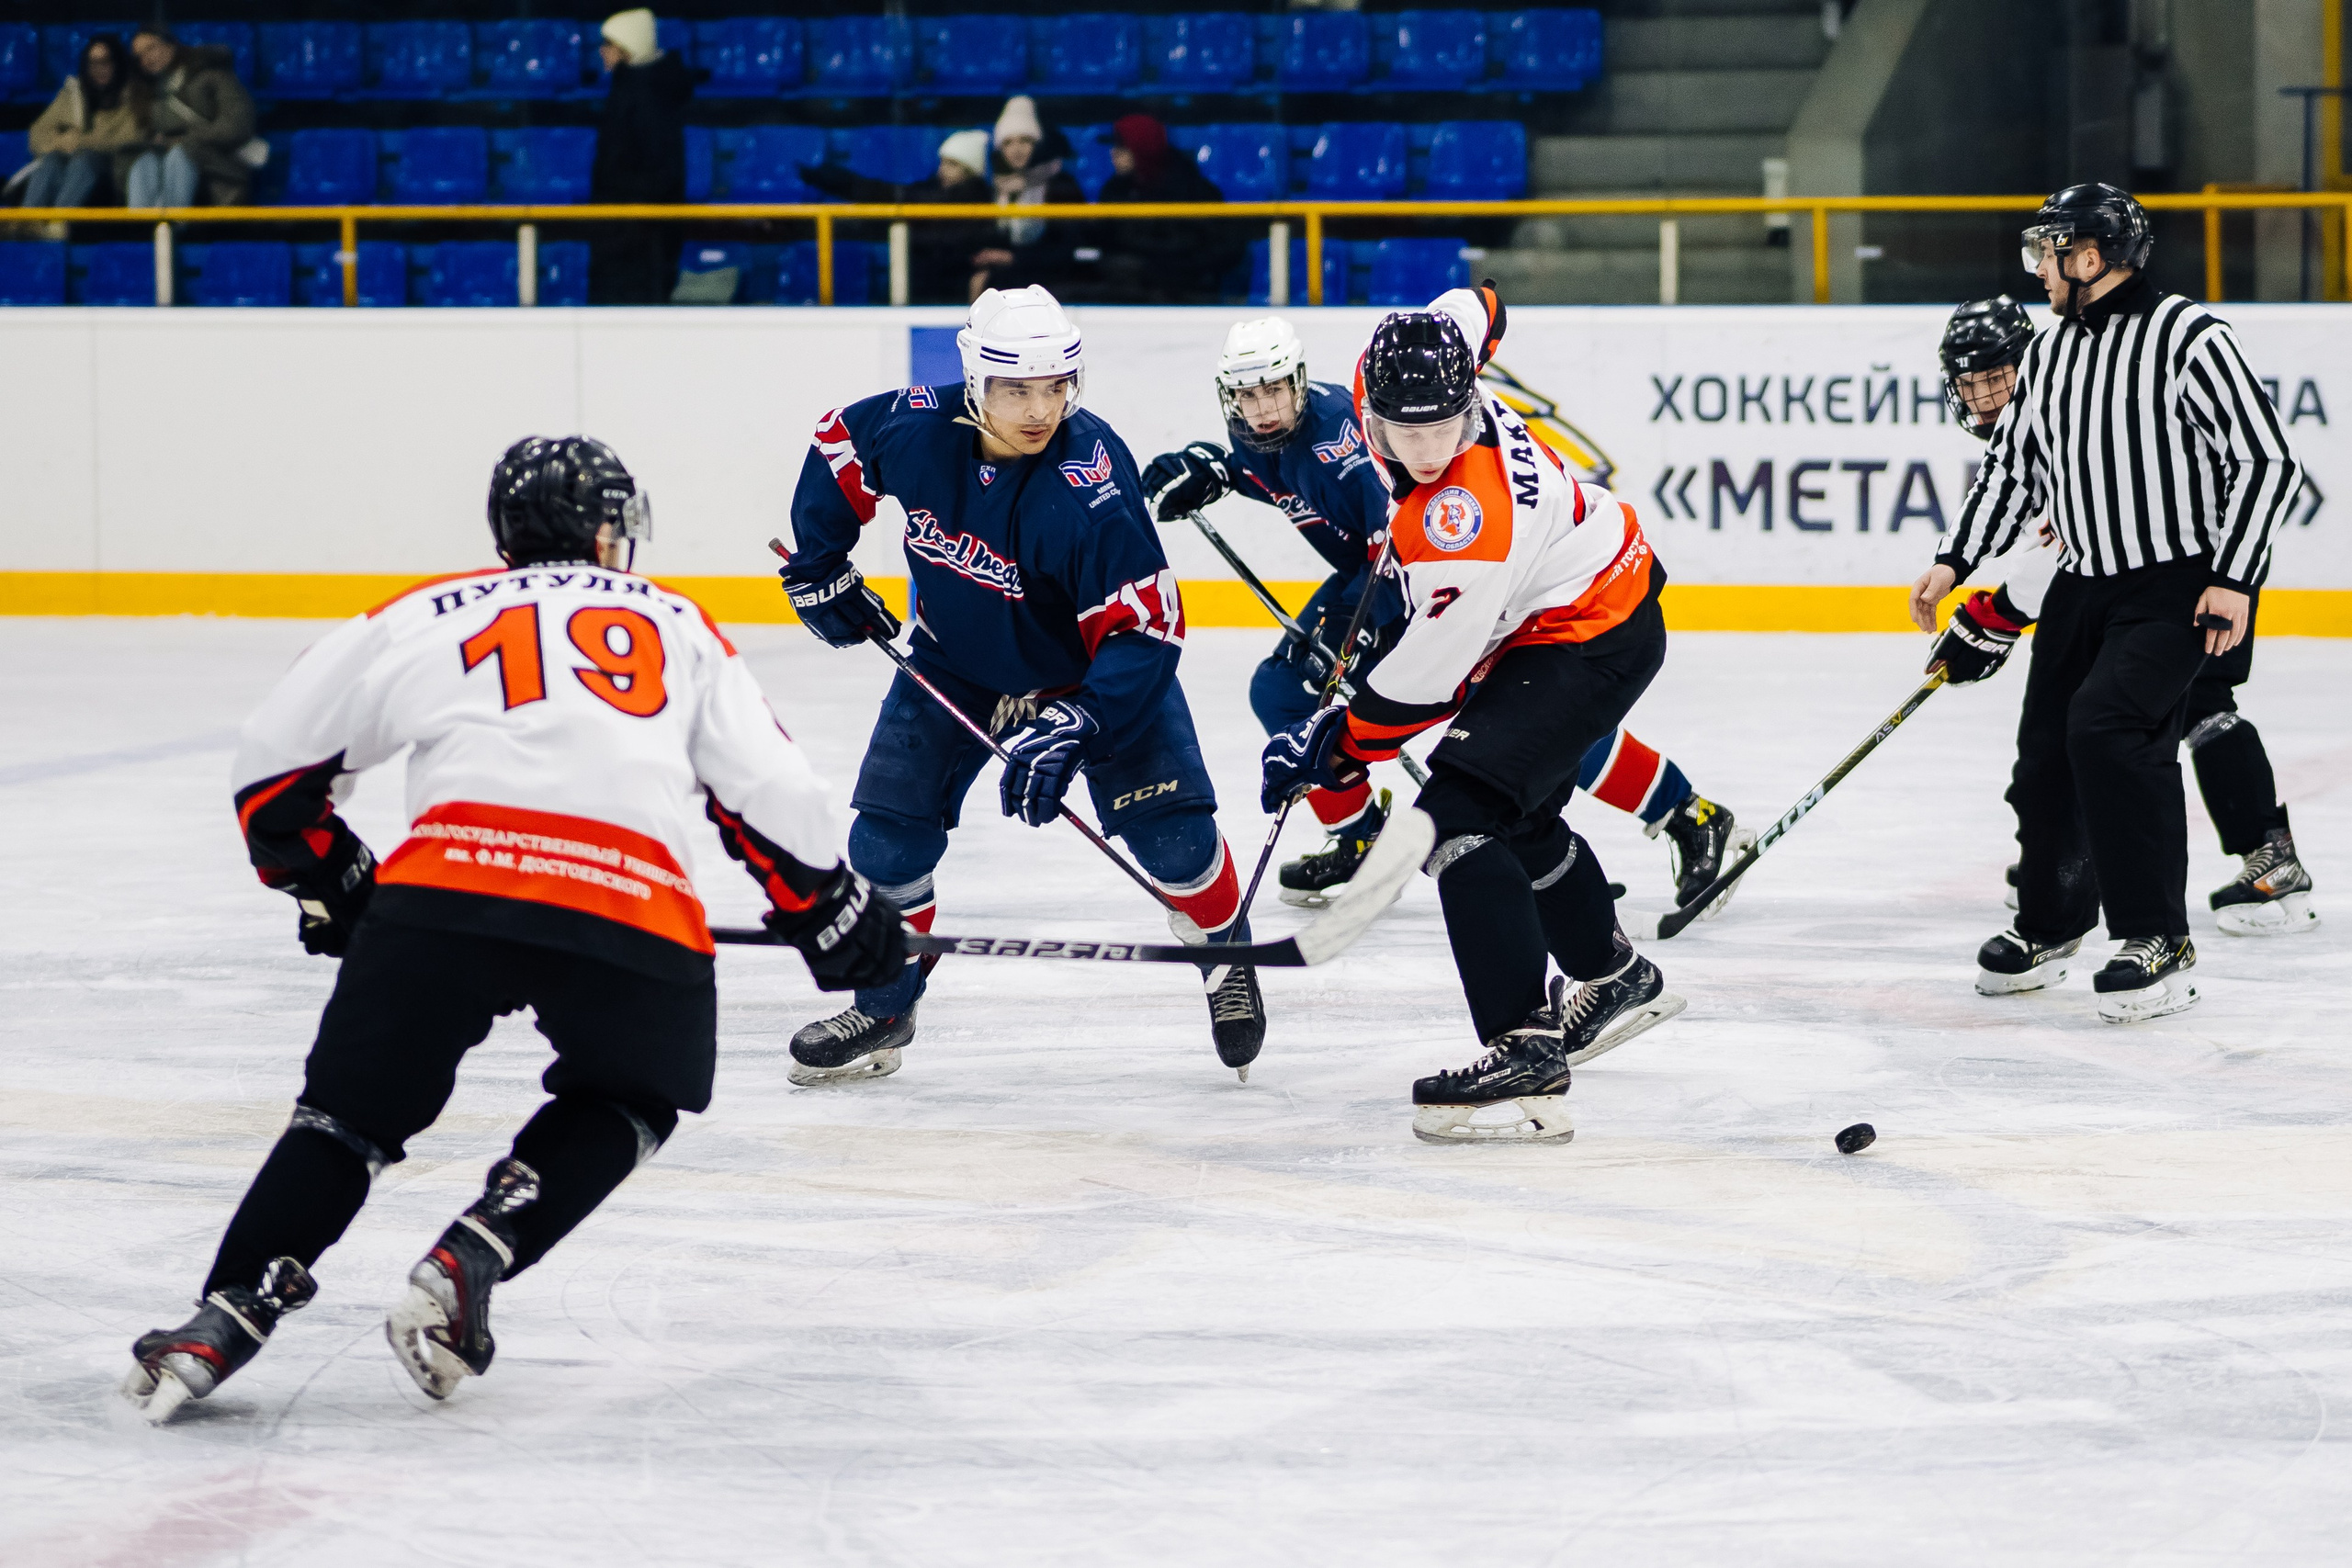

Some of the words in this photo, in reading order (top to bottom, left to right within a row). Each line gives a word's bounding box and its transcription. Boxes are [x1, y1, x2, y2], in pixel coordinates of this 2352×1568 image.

[1401, 404, 1438, 417] BAUER
[1651, 364, 1948, 426] ХОККЕЙН
[431, 572, 683, 617] ПУТУЛЯ
[792, 565, 862, 608] BAUER
[1119, 569, 1180, 642] 14
[1948, 615, 2009, 655] BAUER
[459, 601, 669, 718] 19
[1113, 779, 1179, 811] CCM
[1757, 783, 1825, 856] CCM
